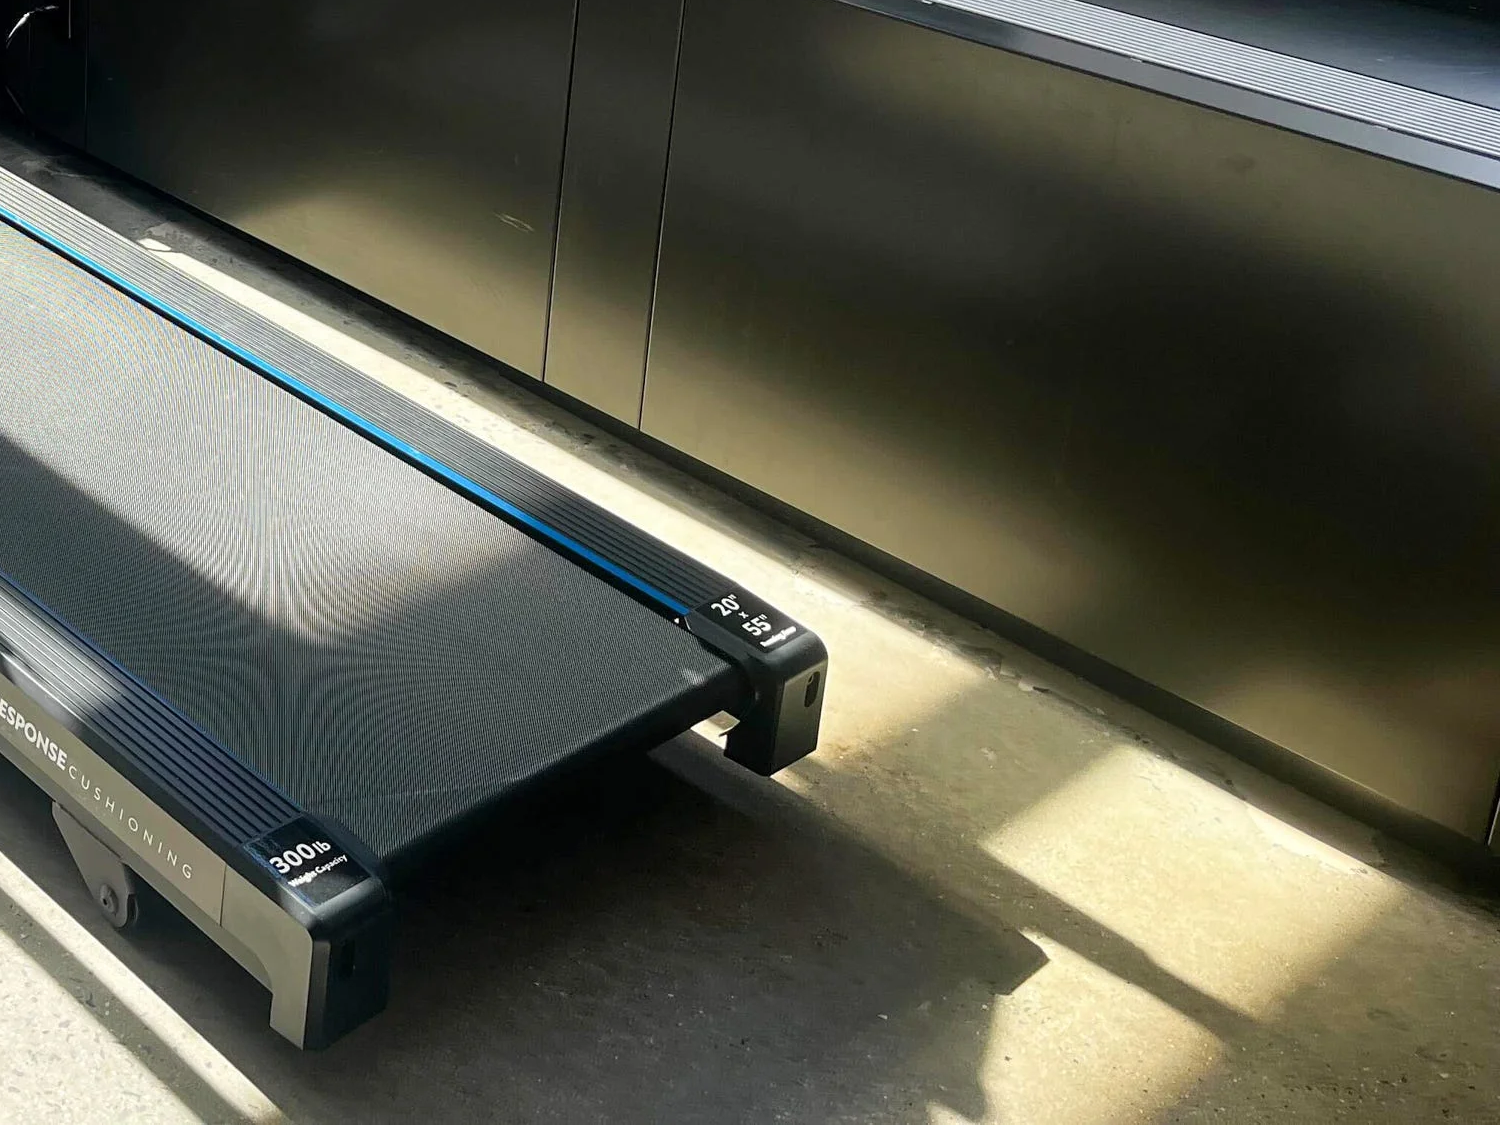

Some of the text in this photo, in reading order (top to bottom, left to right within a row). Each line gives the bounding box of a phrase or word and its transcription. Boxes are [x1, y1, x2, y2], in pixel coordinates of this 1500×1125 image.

[68, 765, 192, 879] CUSHIONING
[287, 854, 348, 887] Weight Capacity
